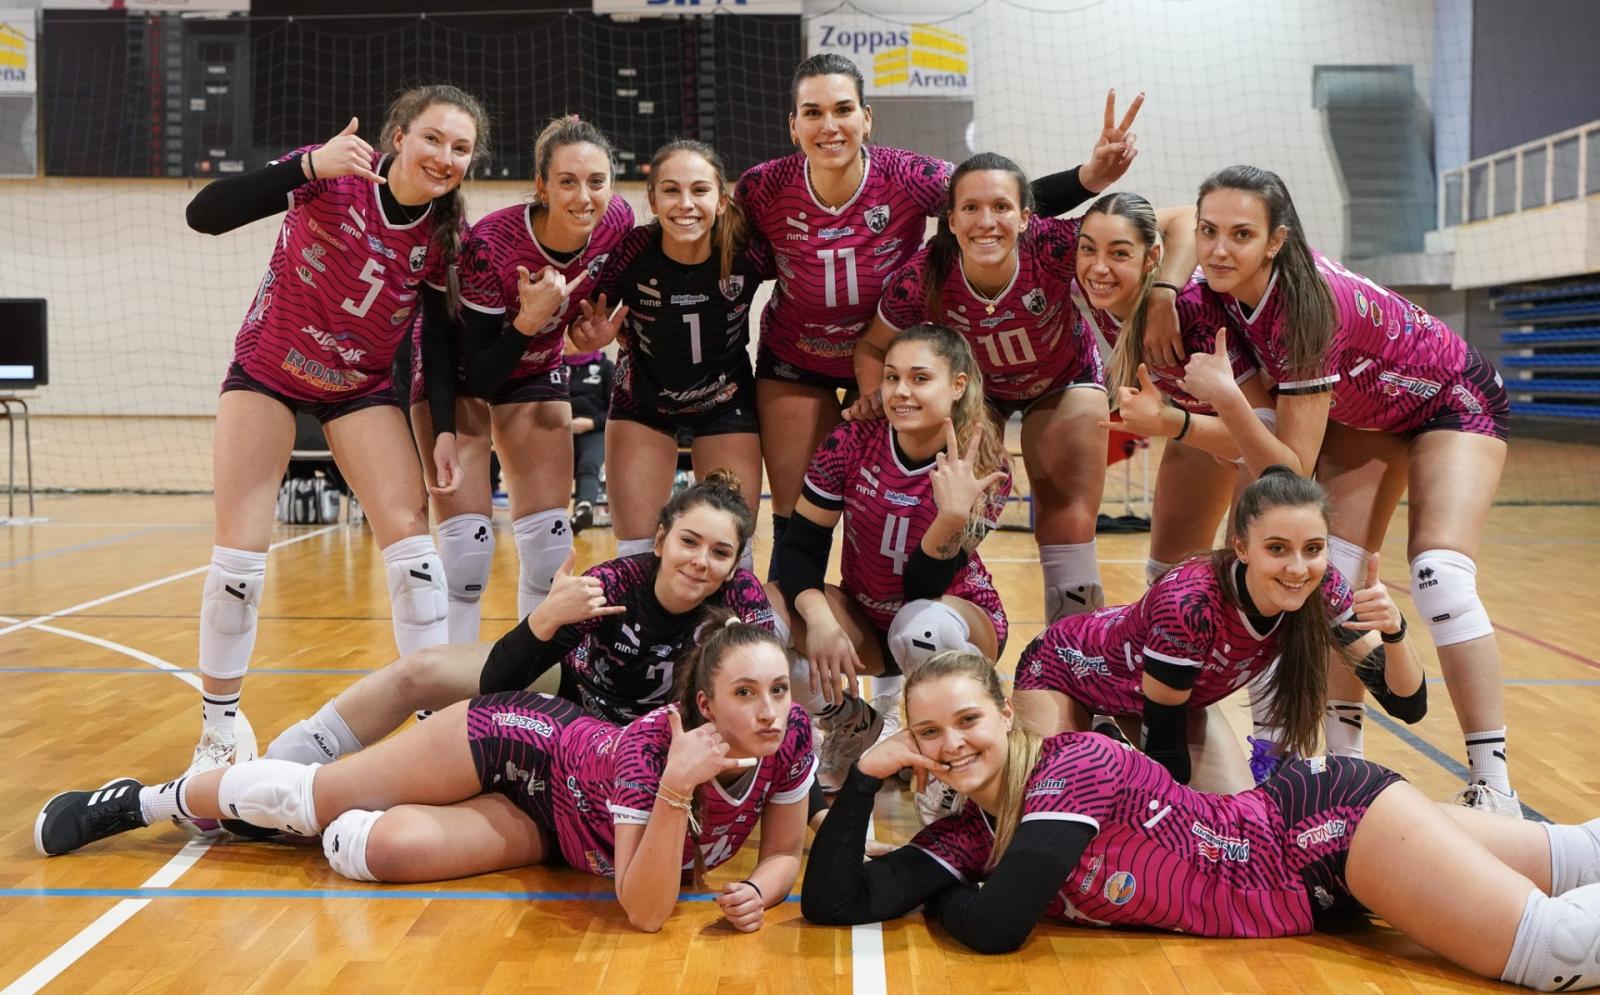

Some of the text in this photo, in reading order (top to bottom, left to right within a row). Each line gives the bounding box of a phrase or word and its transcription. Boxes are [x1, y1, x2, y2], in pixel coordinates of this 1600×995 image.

[819, 25, 909, 53] Zoppas
[0, 70, 25, 81] na
[909, 70, 968, 88] Arena
[340, 222, 363, 240] nine
[786, 233, 809, 241] nine
[341, 258, 386, 319] 5
[816, 247, 860, 308] 11
[639, 299, 662, 307] nine
[682, 313, 702, 365] 1
[977, 327, 1038, 367] 10
[856, 484, 877, 498] nine
[880, 513, 910, 576] 4
[614, 641, 640, 656] nine
[636, 661, 674, 704] 2
[312, 733, 334, 759] MIKASA
